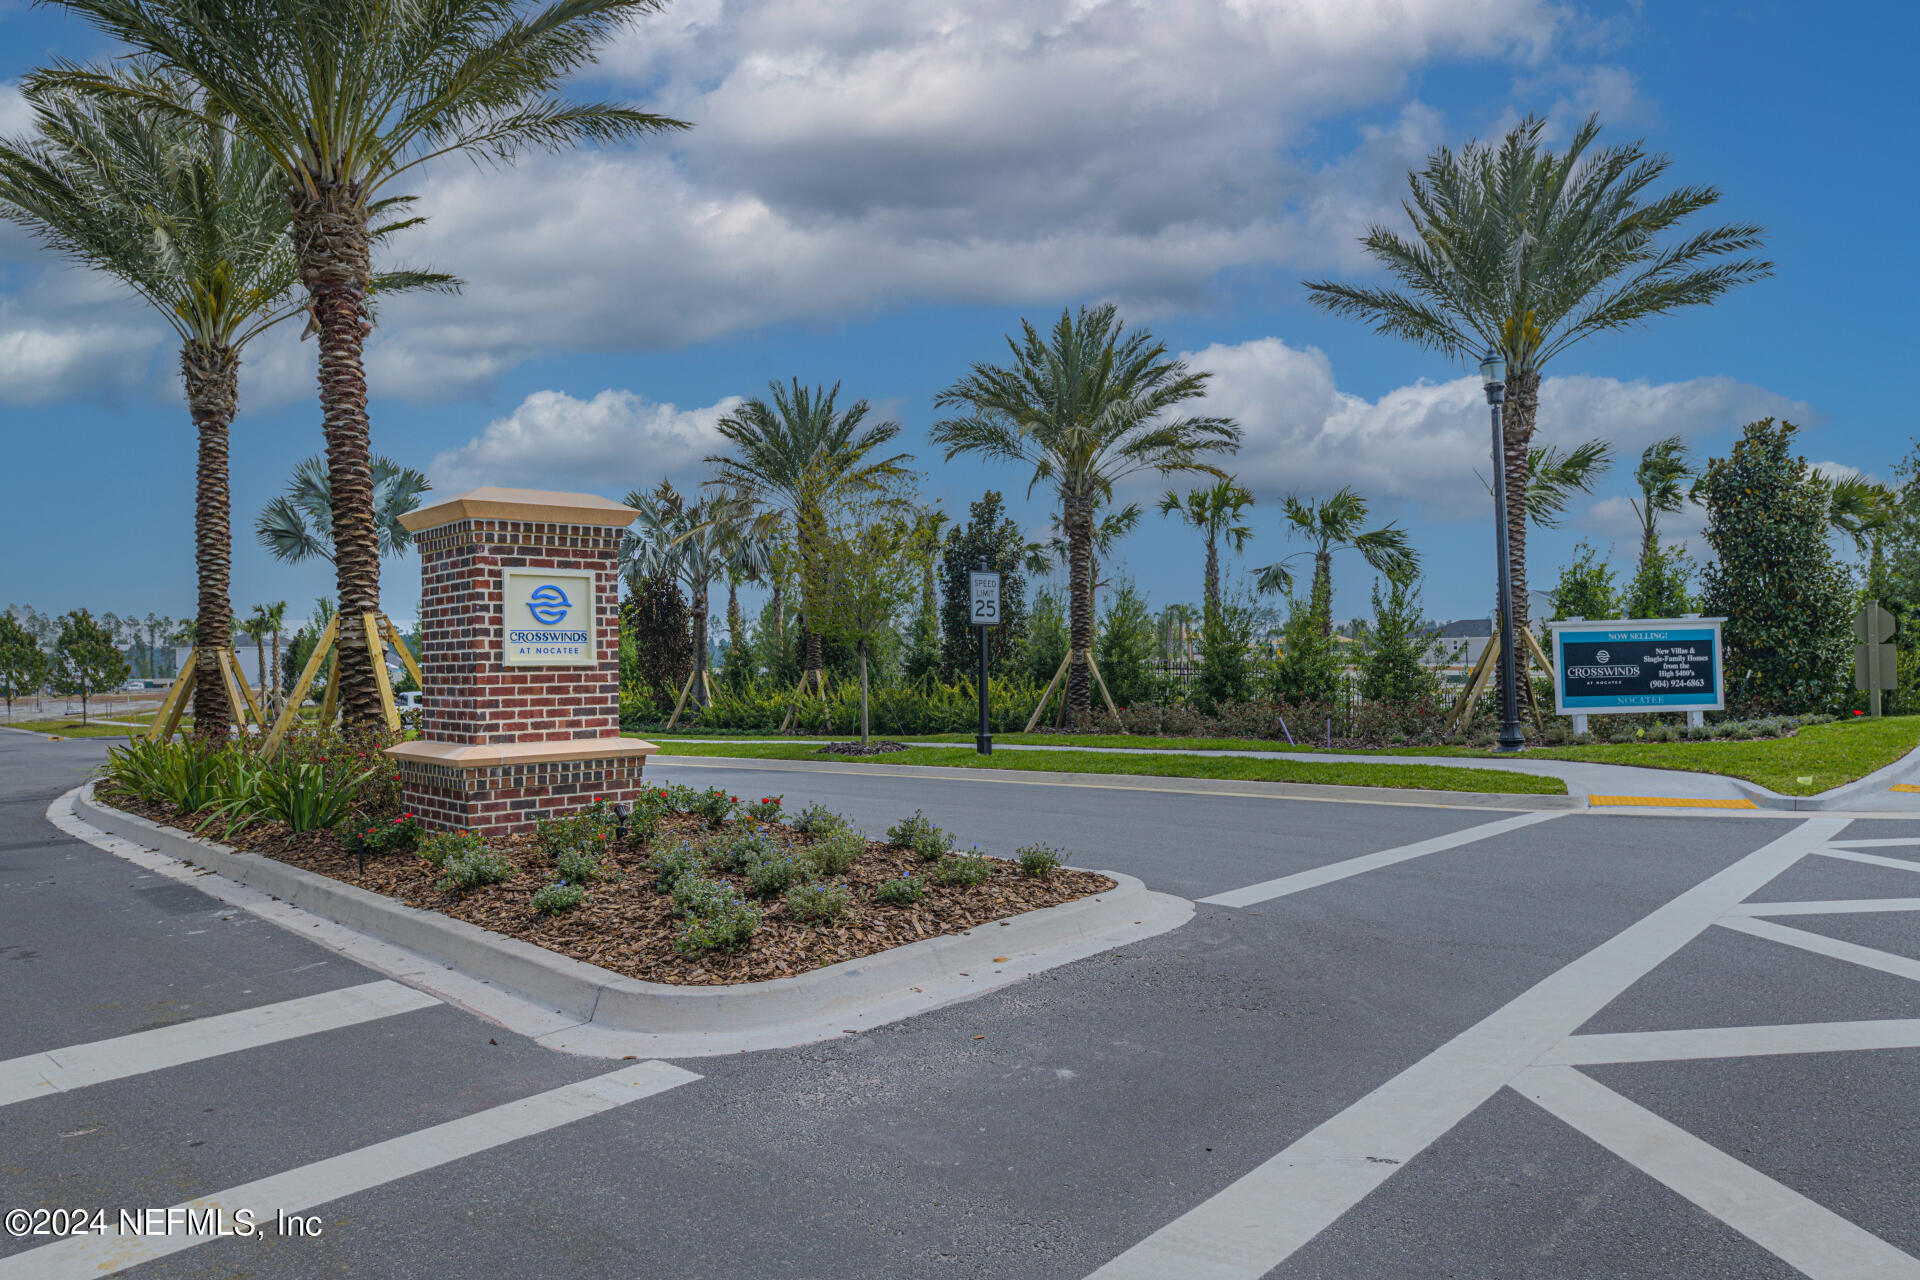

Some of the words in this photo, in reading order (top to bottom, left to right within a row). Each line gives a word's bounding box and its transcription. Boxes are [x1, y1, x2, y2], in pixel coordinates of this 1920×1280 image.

[974, 579, 997, 588] SPEED
[975, 600, 996, 617] 25
[509, 631, 588, 643] CROSSWINDS
[1629, 631, 1668, 640] SELLING!
[519, 647, 531, 655] AT
[535, 647, 580, 655] NOCATEE
[1671, 647, 1688, 655] Villas
[1643, 655, 1686, 664] Single-Family
[1687, 654, 1709, 662] Homes
[1567, 666, 1640, 678] CROSSWINDS
[1658, 670, 1674, 678] High
[1650, 680, 1669, 689] (904)
[1670, 678, 1705, 688] 924-6863
[1617, 696, 1665, 704] NOCATEE
